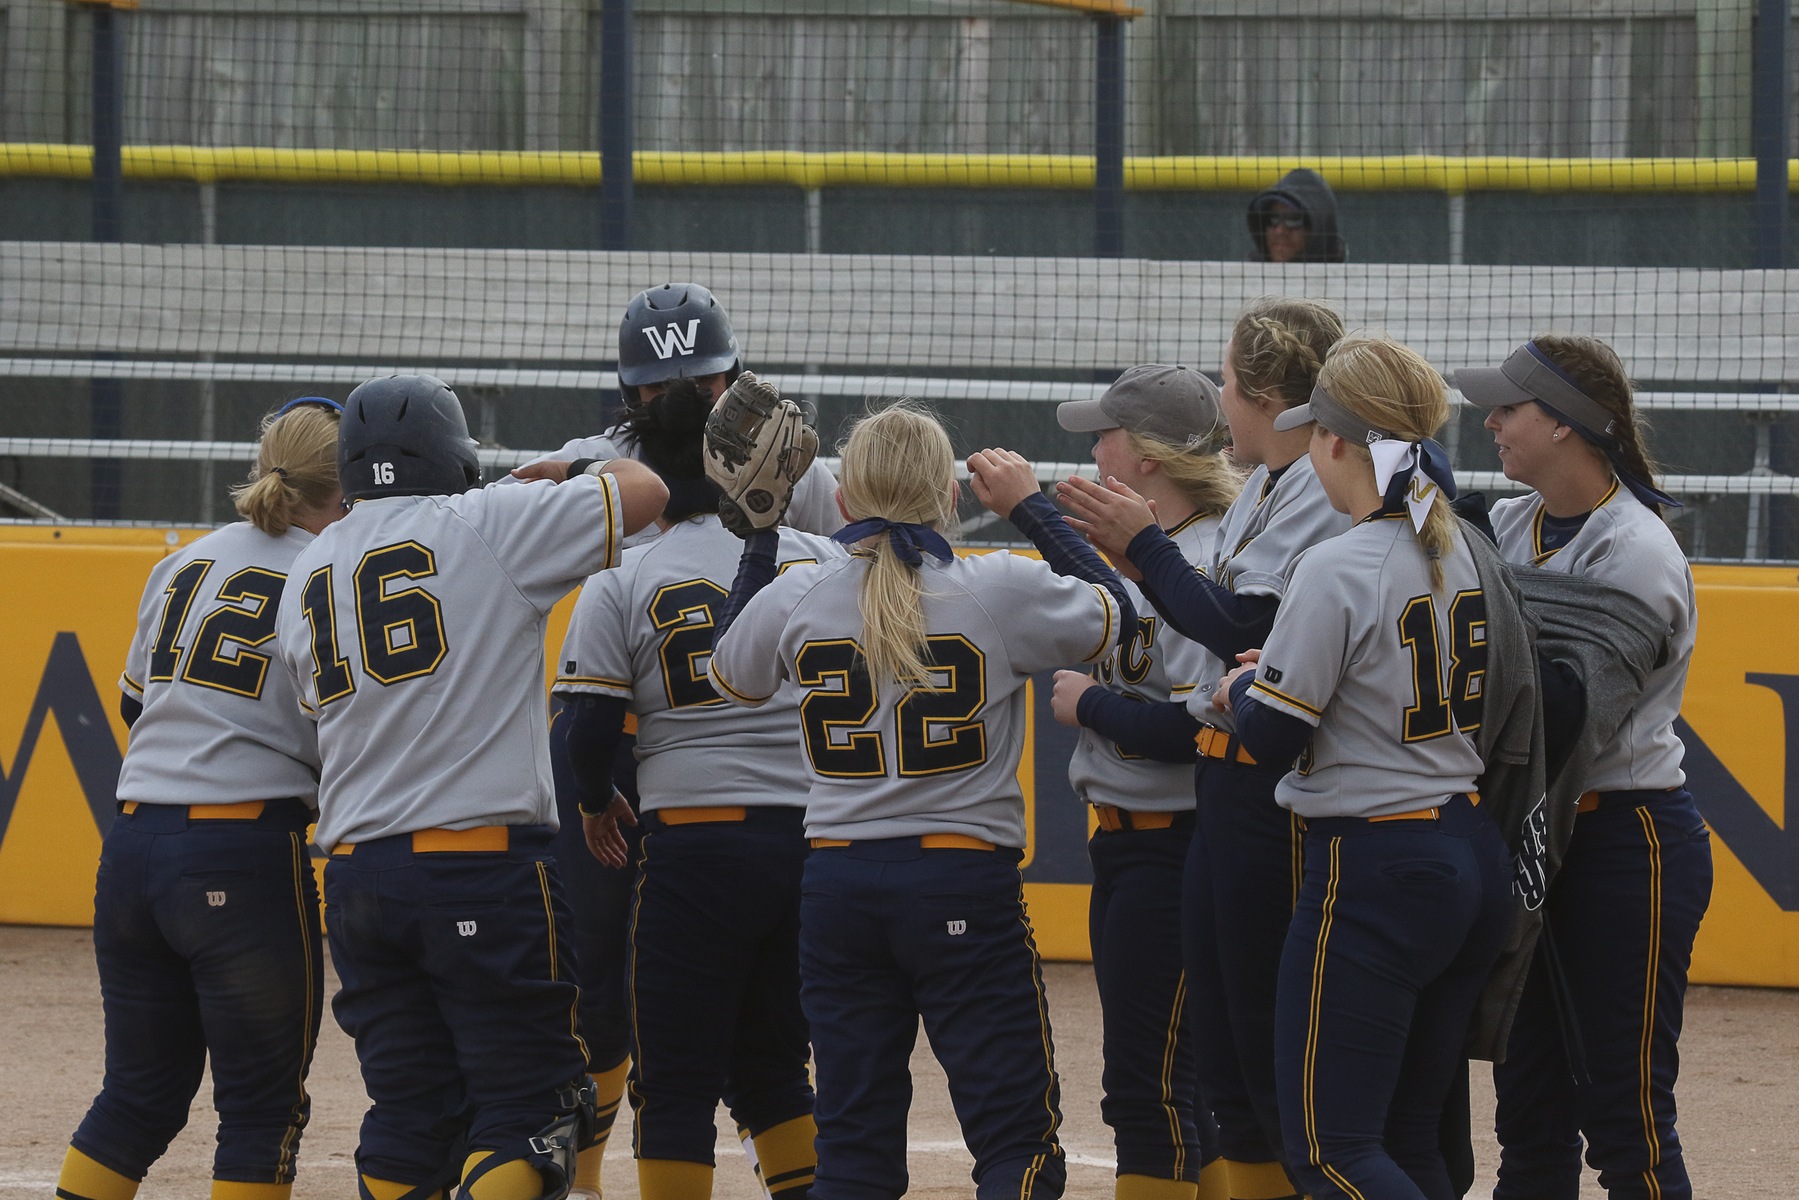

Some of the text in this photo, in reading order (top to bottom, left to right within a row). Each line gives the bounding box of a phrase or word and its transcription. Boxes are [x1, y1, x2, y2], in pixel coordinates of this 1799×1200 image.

[642, 319, 700, 359] W
[373, 463, 394, 484] 16
[150, 559, 288, 700] 12
[301, 539, 449, 707] 16
[1397, 588, 1488, 744] 18
[796, 633, 986, 778] 22
